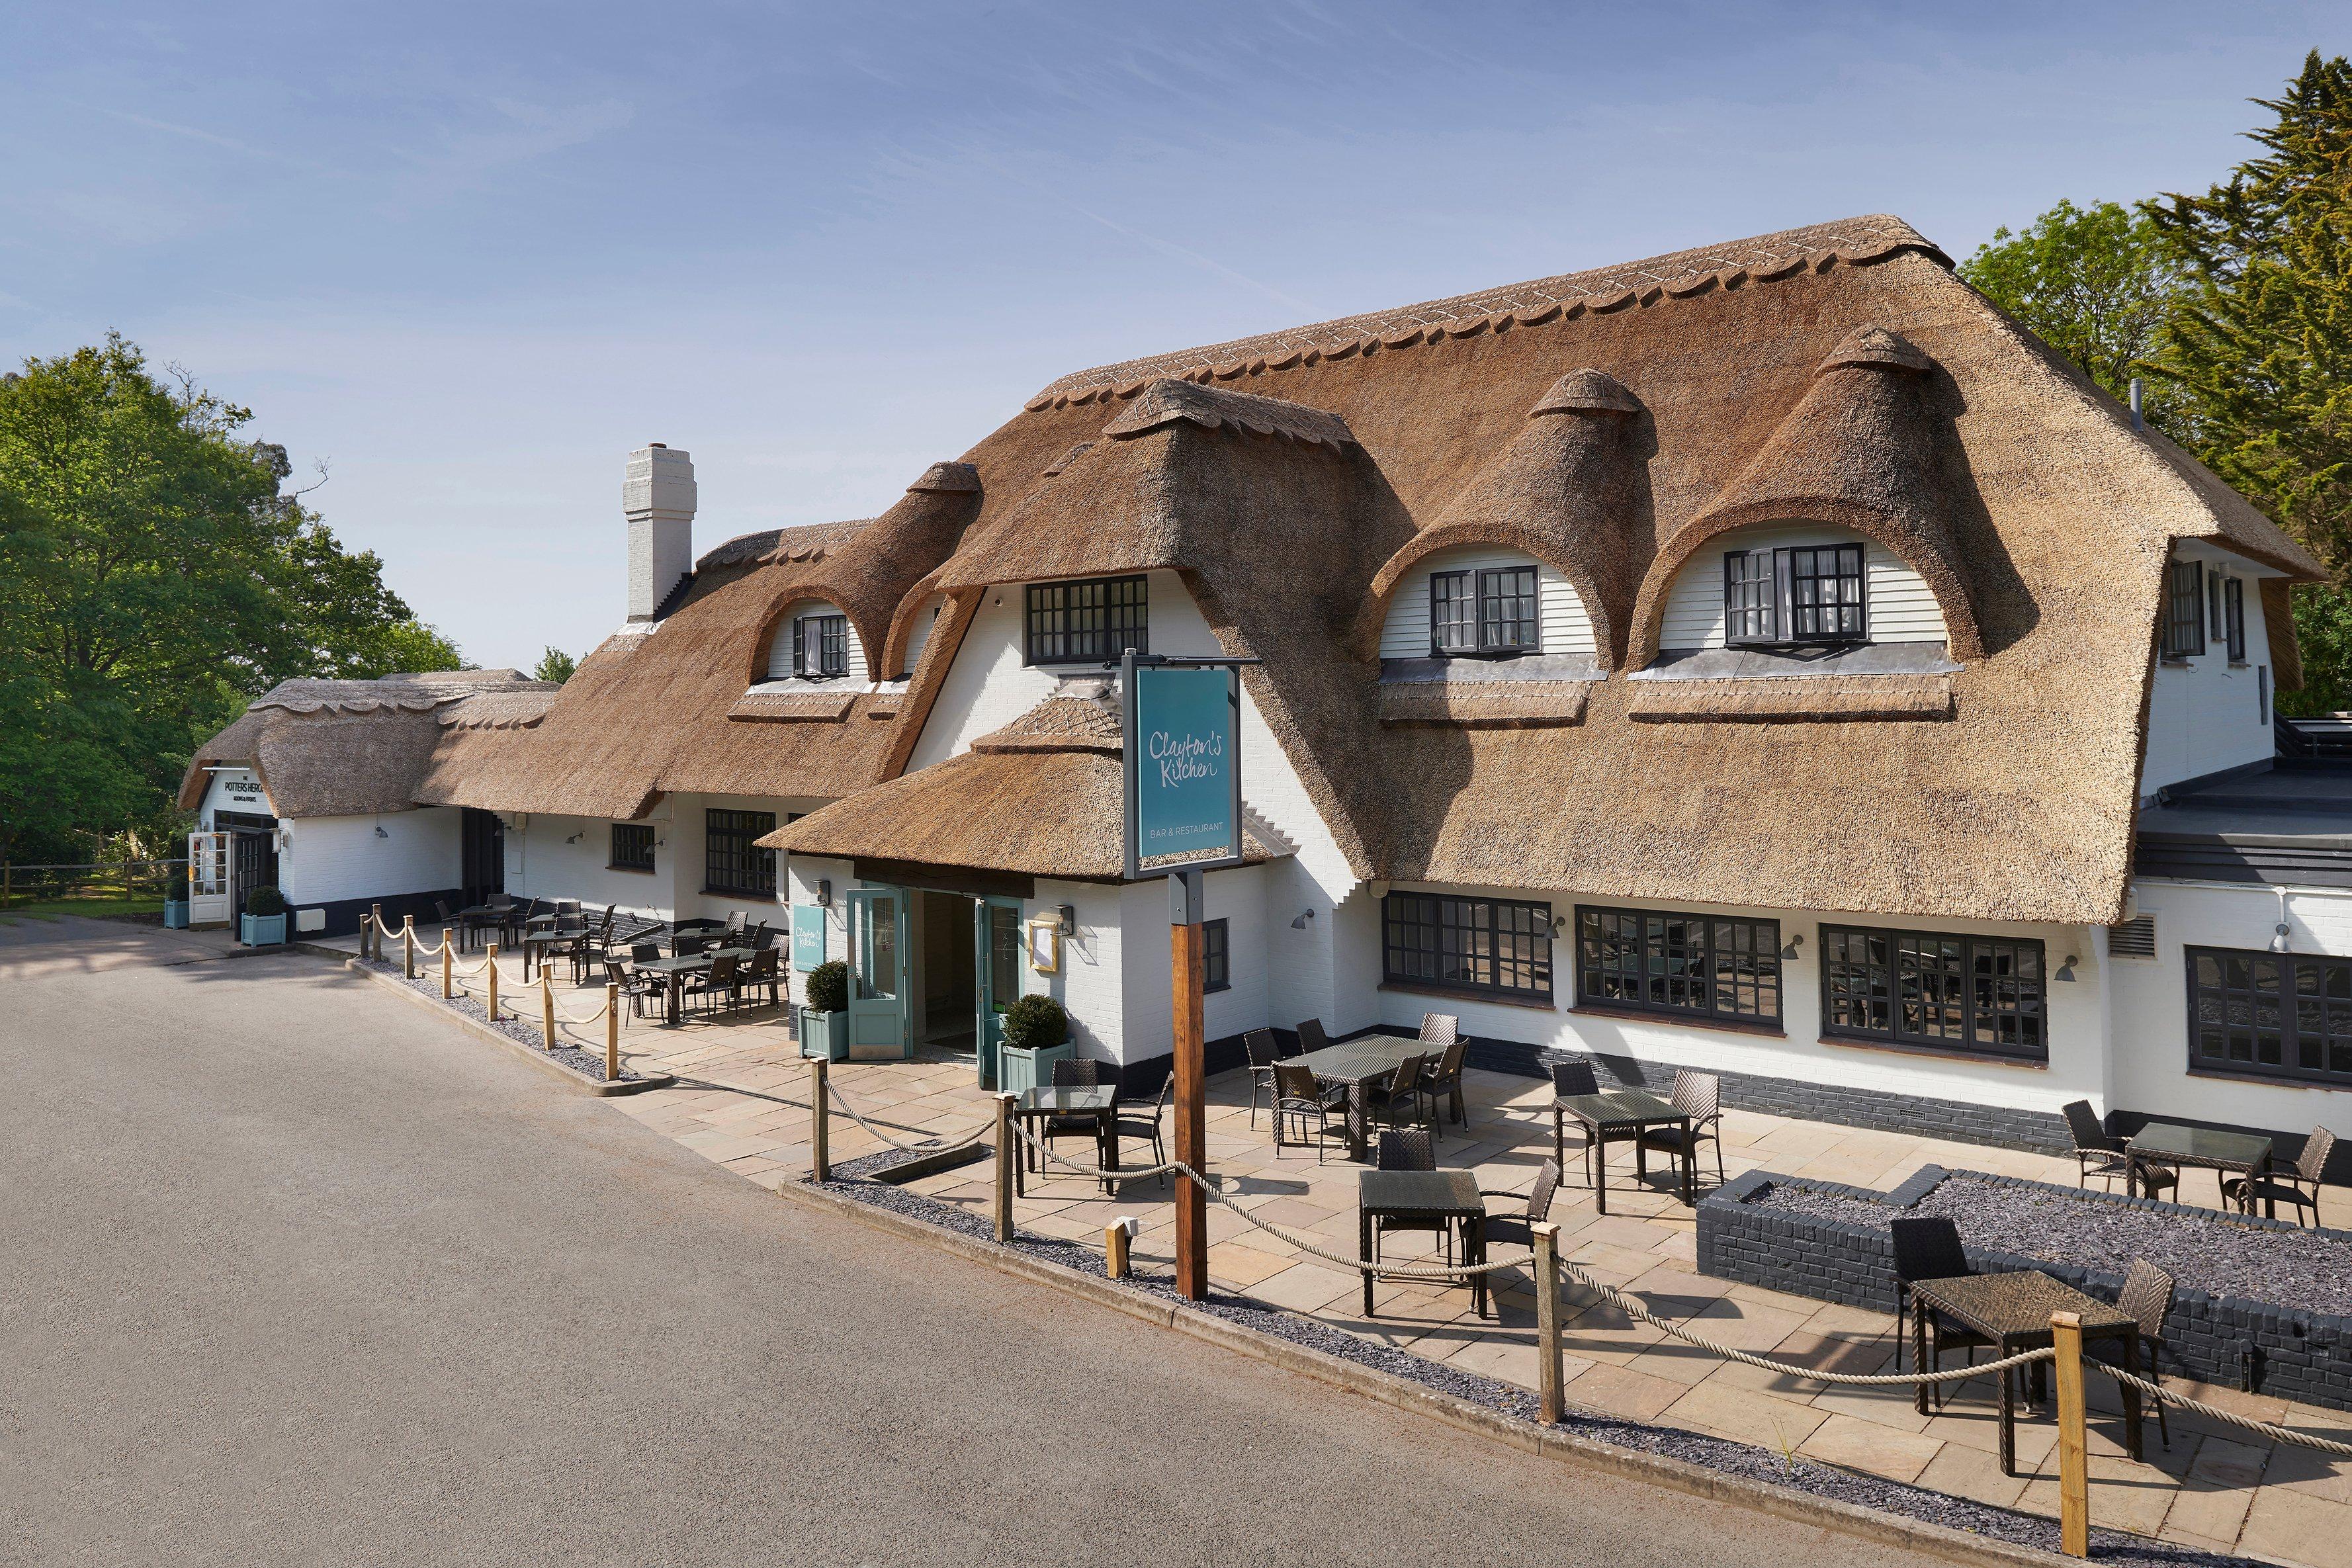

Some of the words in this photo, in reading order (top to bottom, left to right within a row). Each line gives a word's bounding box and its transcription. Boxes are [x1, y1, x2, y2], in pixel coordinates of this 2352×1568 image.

[1149, 730, 1222, 765] Clayton's
[1160, 757, 1218, 787] Kitchen
[225, 781, 247, 793] POTTERS
[1150, 829, 1166, 839] BAR
[1168, 828, 1174, 836] &
[1175, 822, 1223, 836] RESTAURANT
[795, 926, 821, 940] Clayton's
[799, 936, 820, 949] Kitchen
